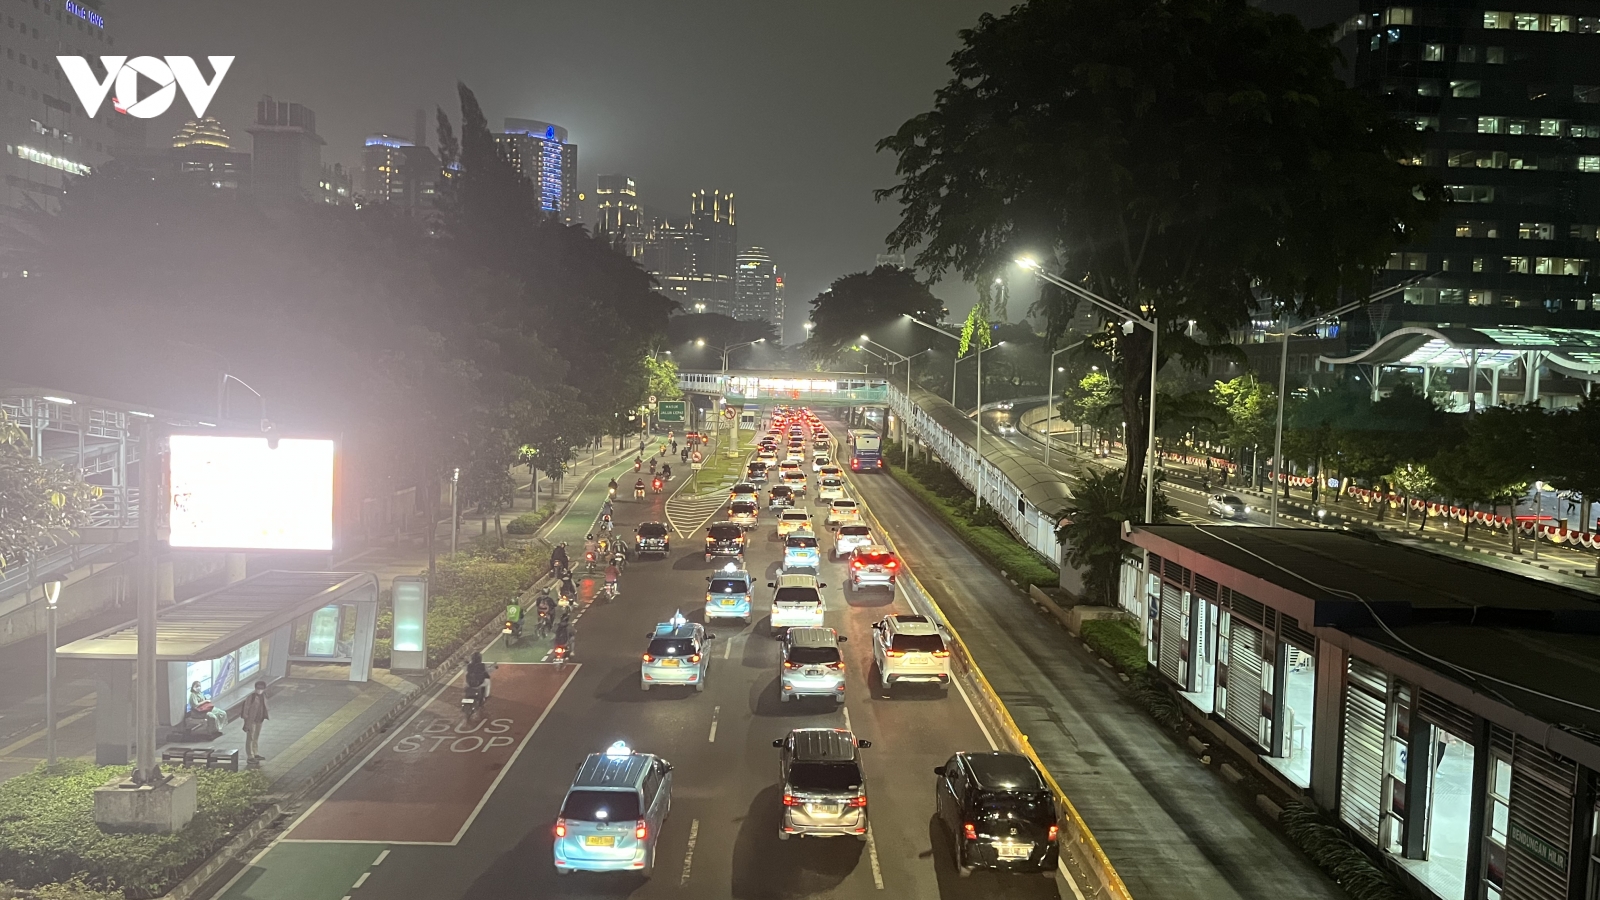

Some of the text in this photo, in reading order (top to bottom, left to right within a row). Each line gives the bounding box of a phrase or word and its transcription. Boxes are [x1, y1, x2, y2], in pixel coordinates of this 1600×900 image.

[422, 718, 514, 734] BUS
[393, 734, 515, 753] STOP
[1512, 827, 1563, 868] BENDUNGAN HILIR
